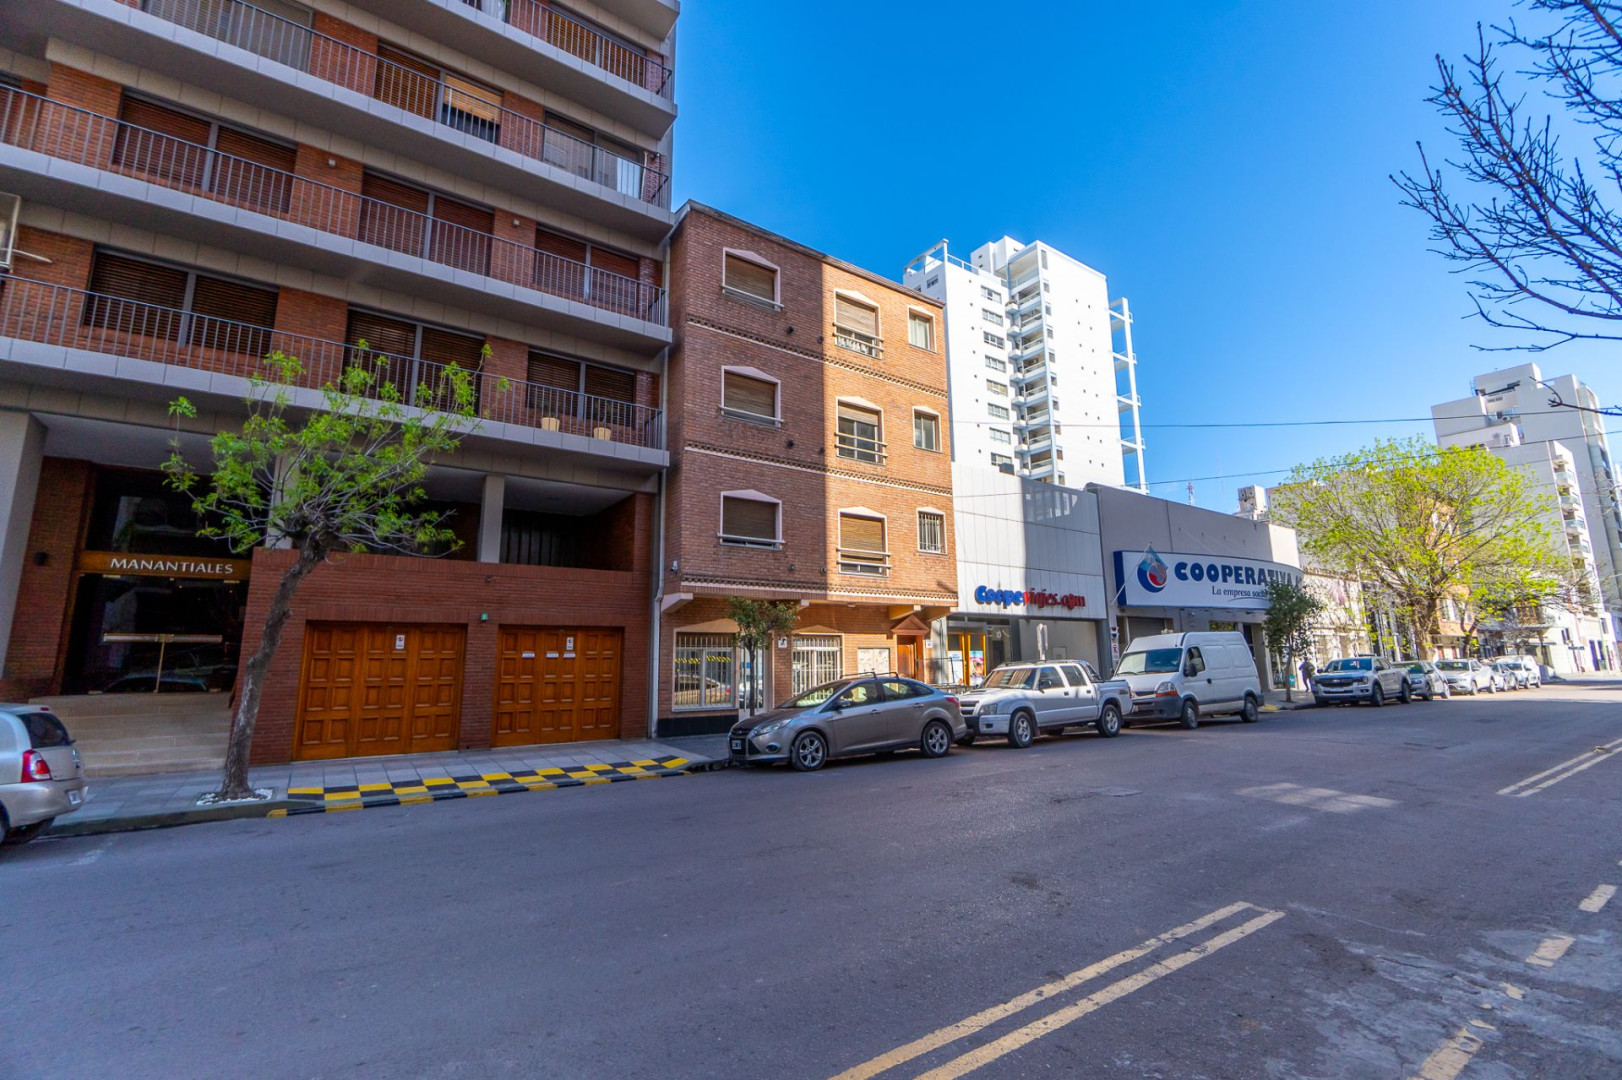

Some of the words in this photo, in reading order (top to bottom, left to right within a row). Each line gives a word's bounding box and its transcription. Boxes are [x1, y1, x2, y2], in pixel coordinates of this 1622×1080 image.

[110, 558, 233, 574] MANANTIALES
[1174, 561, 1293, 587] COOPERATIVA
[1211, 585, 1222, 595] La
[1223, 588, 1251, 598] empresa
